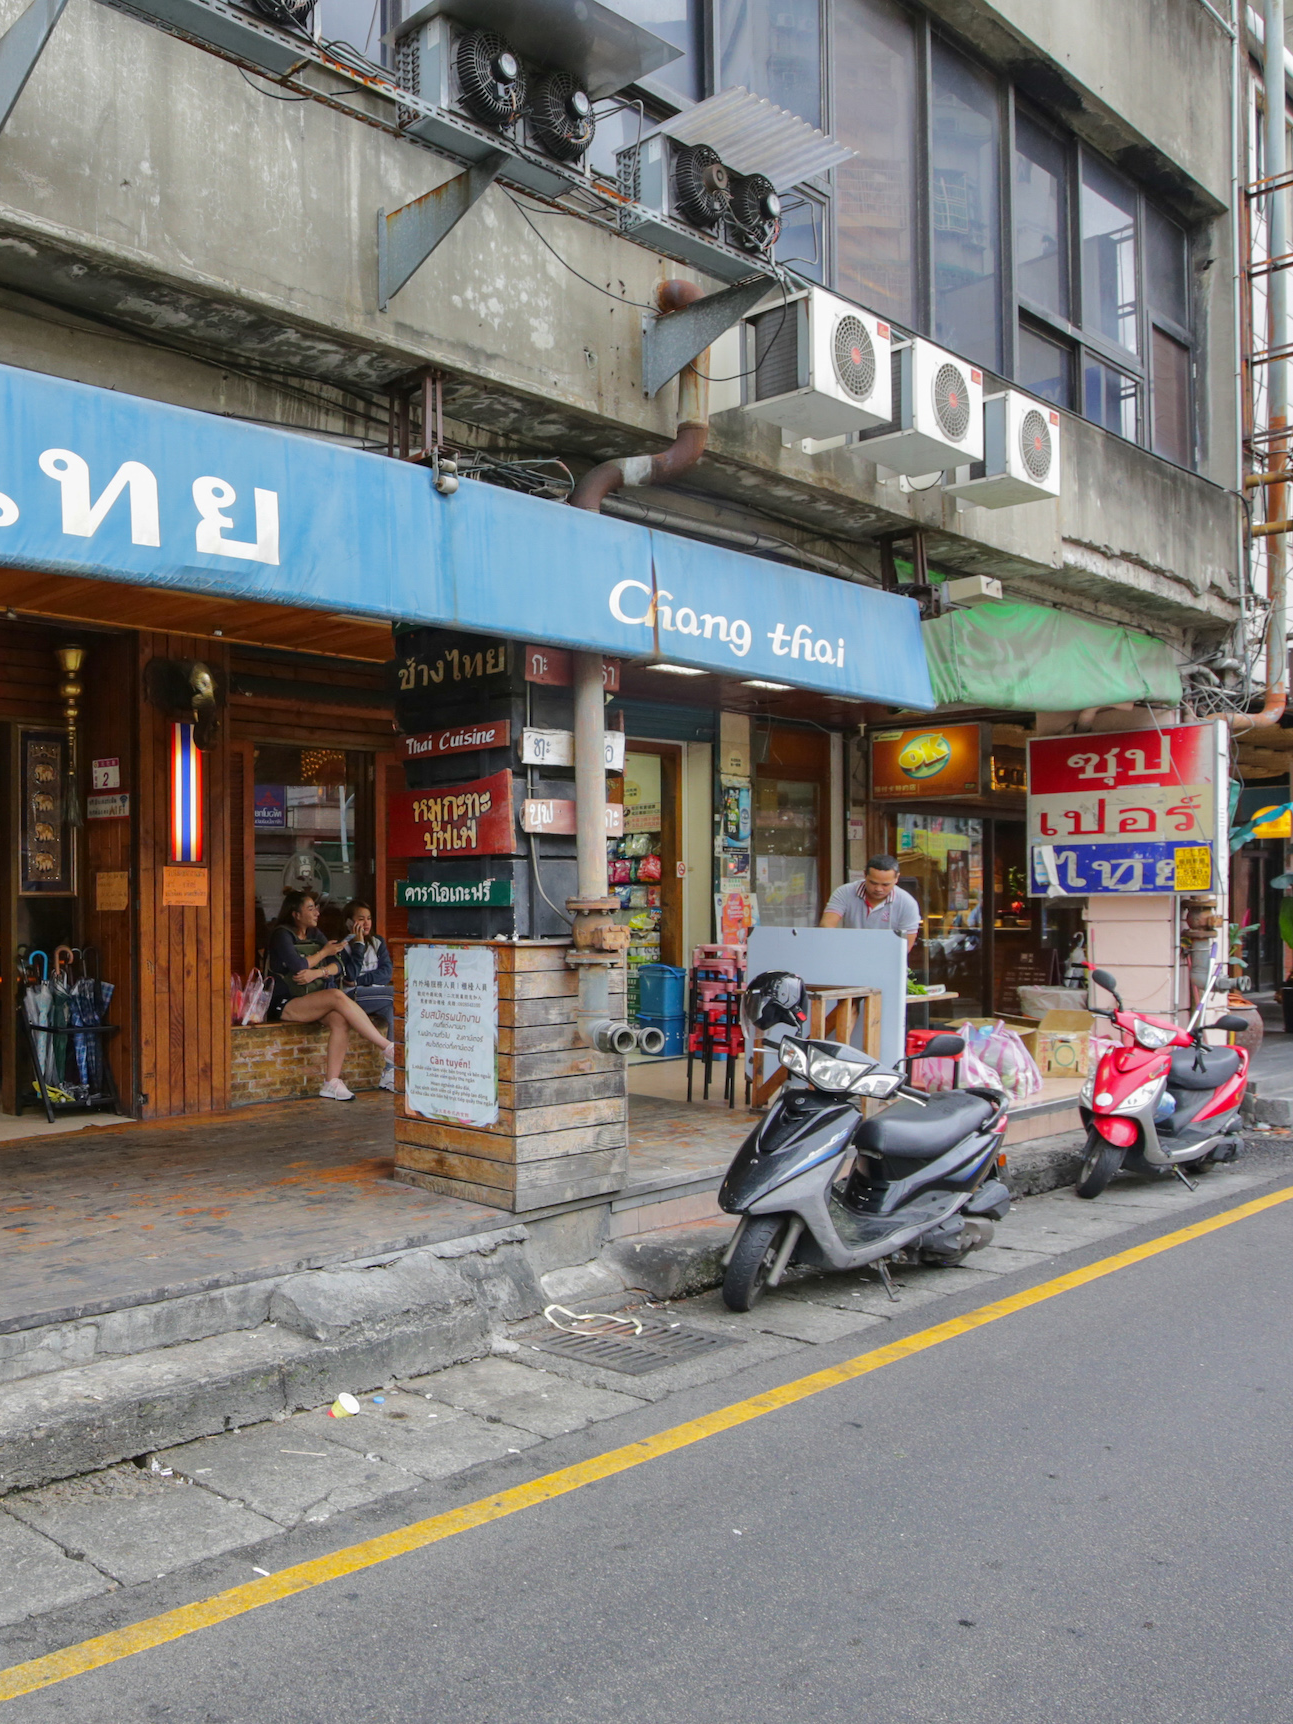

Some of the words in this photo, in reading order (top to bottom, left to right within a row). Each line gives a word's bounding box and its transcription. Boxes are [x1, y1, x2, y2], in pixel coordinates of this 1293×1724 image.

[609, 579, 752, 657] Chang
[767, 623, 845, 668] thai
[398, 646, 505, 690] ช้างไทย
[406, 735, 432, 755] Thai
[439, 727, 495, 749] Cuisine
[899, 733, 950, 769] OK
[1067, 735, 1171, 786] ซุป
[102, 772, 109, 786] 2
[1040, 794, 1202, 836] เปอร์
[438, 953, 458, 978] 徵
